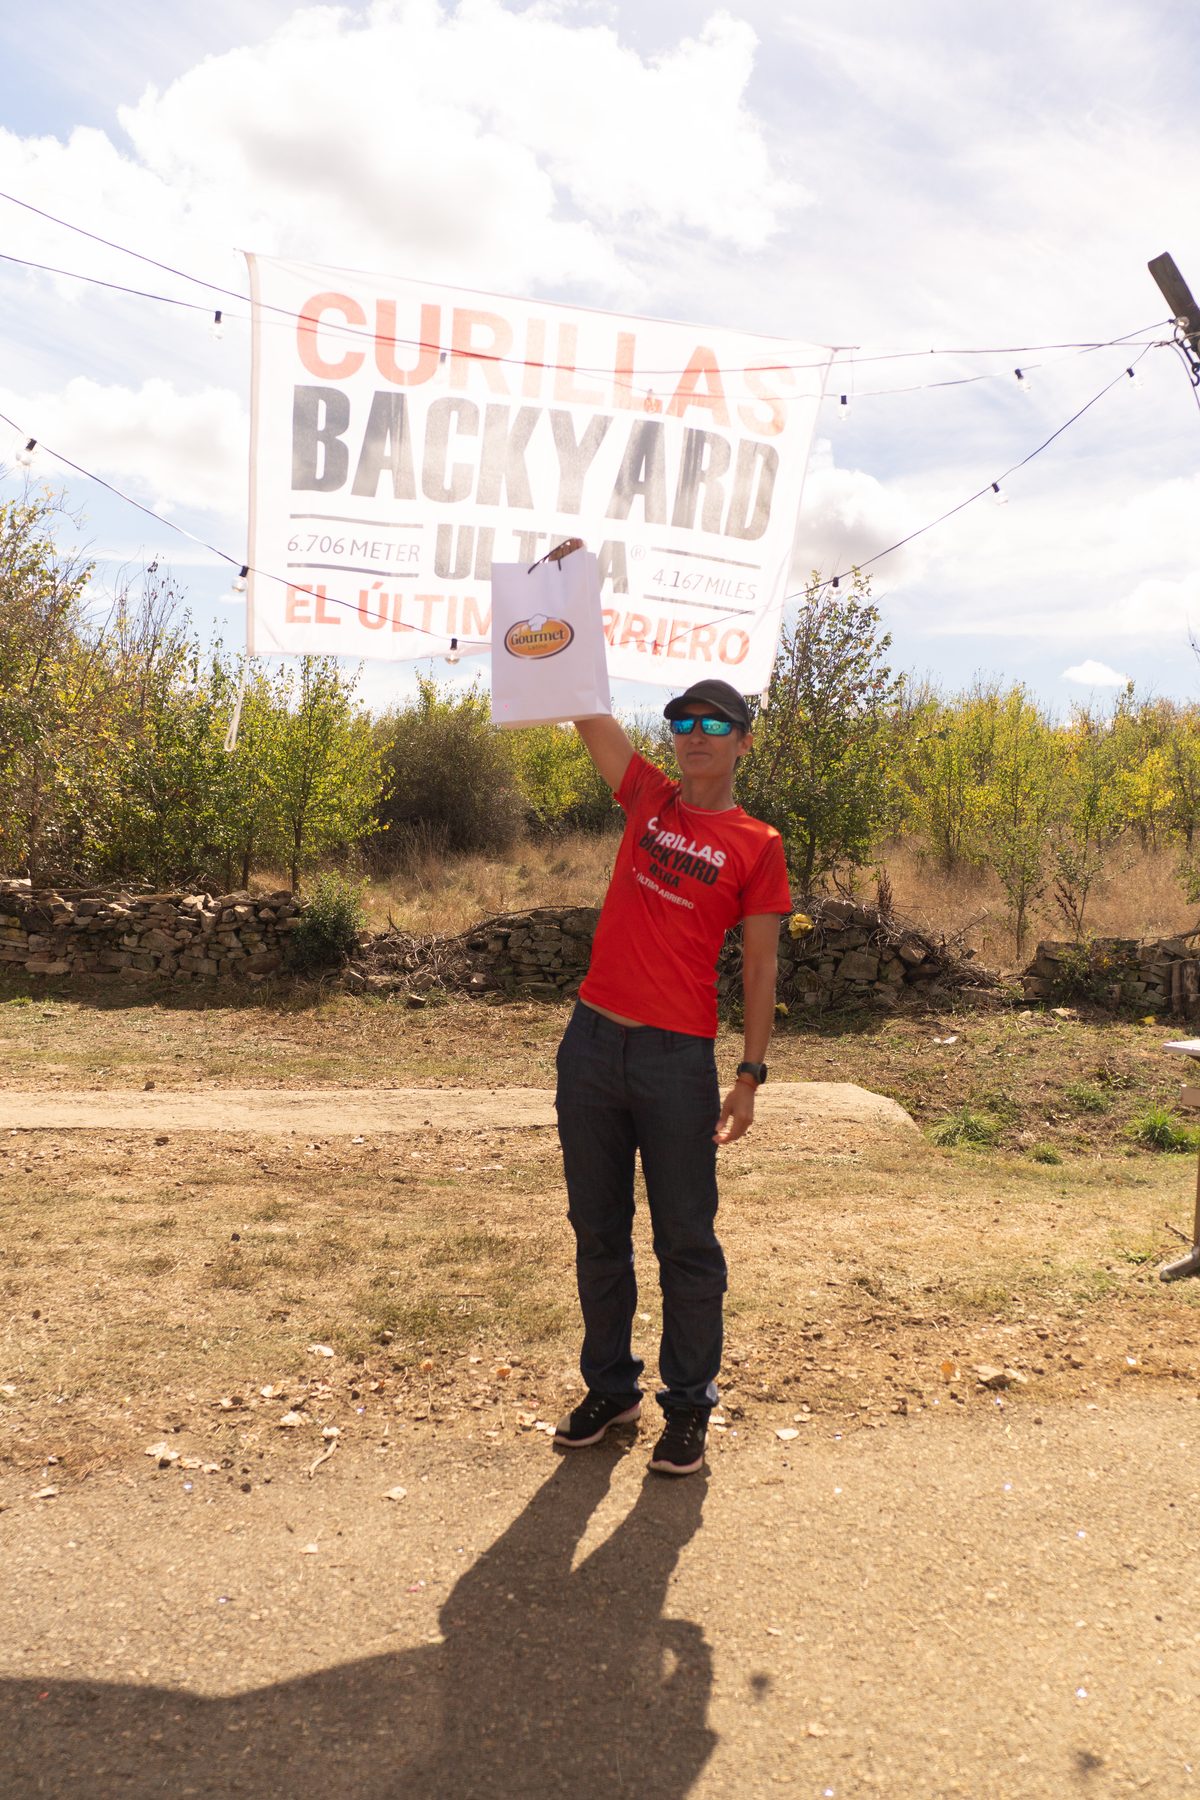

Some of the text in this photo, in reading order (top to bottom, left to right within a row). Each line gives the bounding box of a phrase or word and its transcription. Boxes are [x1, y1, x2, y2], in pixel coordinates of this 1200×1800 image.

[297, 291, 797, 437] CURILLAS
[291, 384, 780, 541] BACKYARD
[287, 534, 420, 563] 6.706 METER
[652, 569, 756, 600] 4.167 MILES
[285, 583, 341, 625] EL
[357, 581, 492, 637] ÚLTIM
[511, 629, 566, 646] Gourmet
